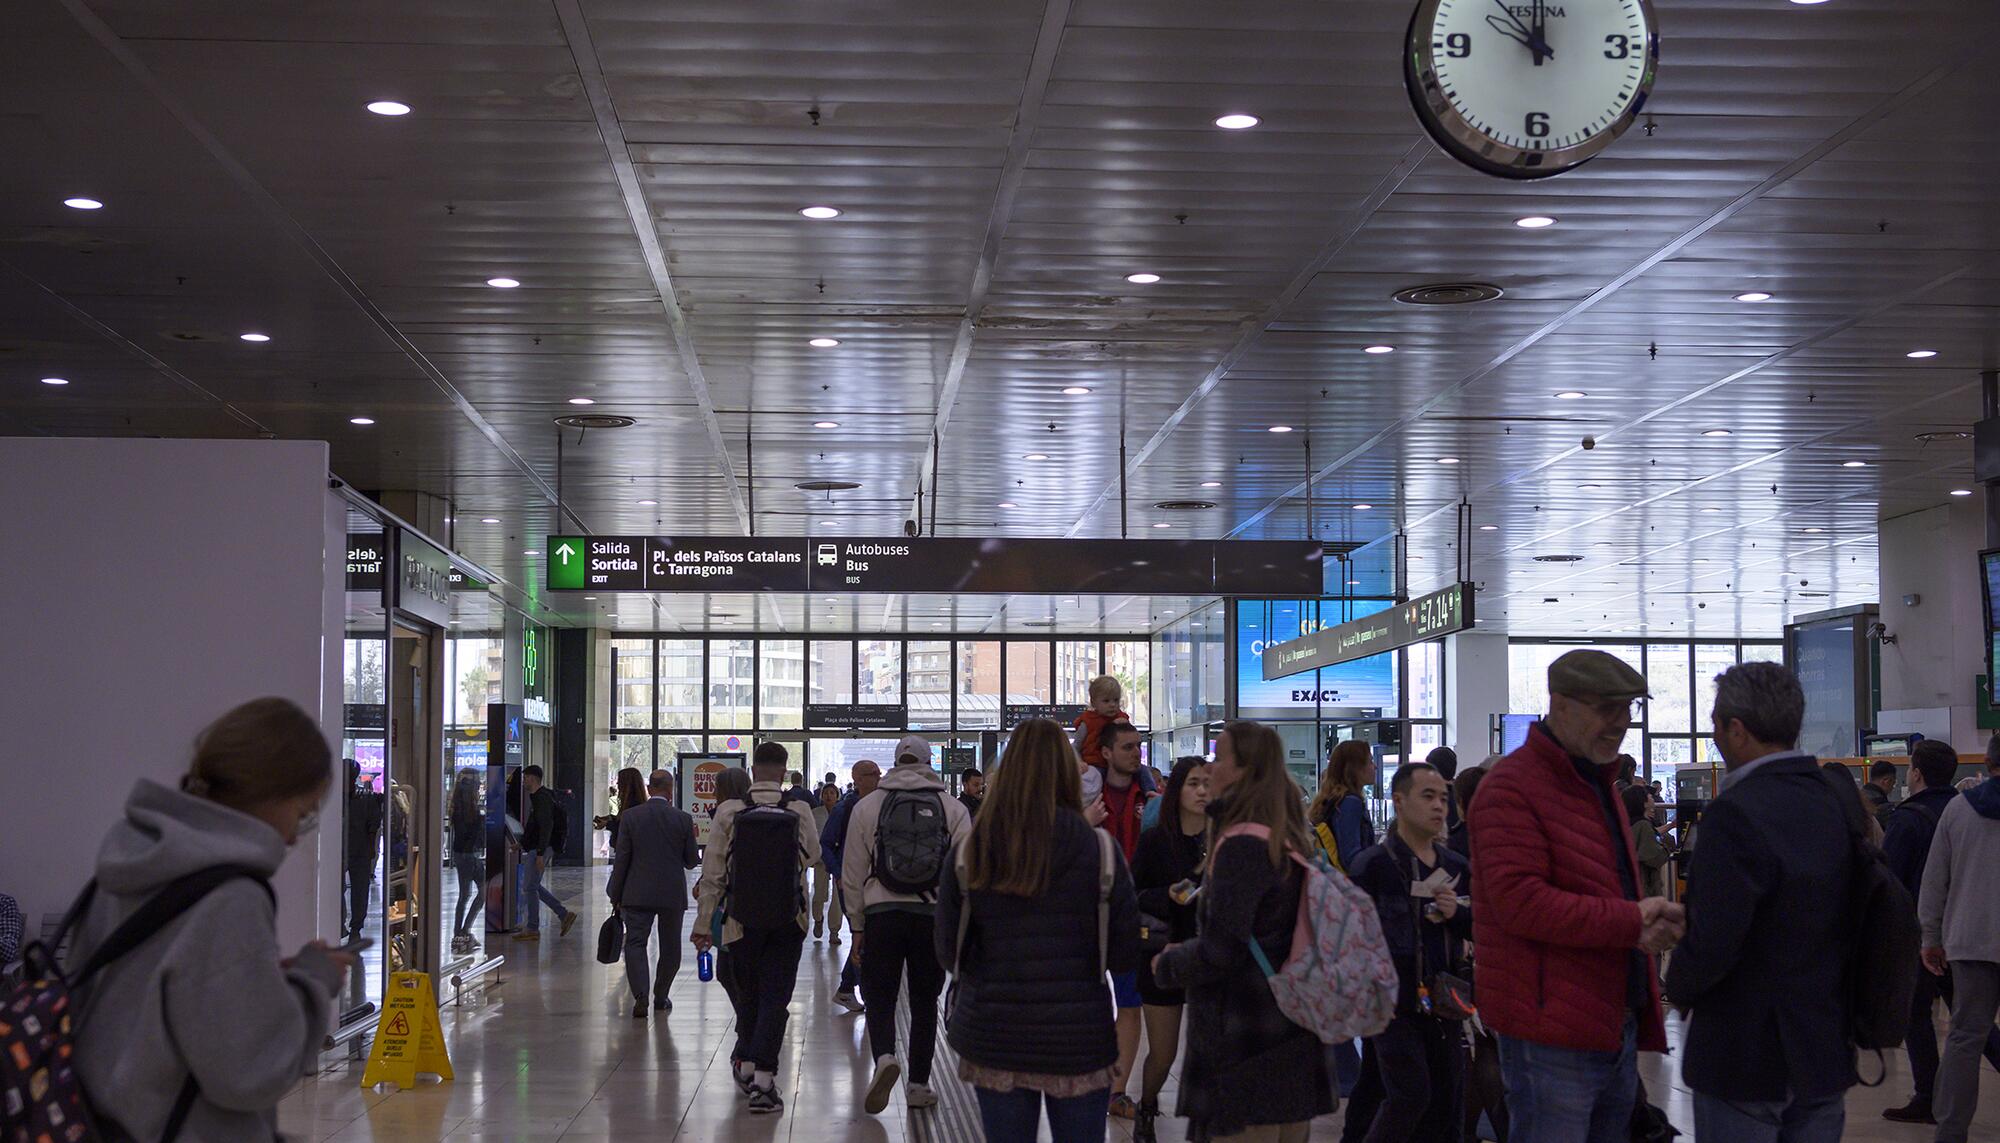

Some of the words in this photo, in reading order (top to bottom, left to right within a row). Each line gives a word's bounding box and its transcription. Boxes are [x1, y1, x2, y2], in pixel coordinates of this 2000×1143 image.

[1509, 5, 1566, 17] FESTNA
[1446, 33, 1471, 58] 9
[1603, 34, 1628, 60] 3
[1525, 112, 1550, 137] 6
[592, 542, 630, 554] Salida
[845, 543, 910, 555] Autobuses
[653, 550, 670, 562] Pl.
[674, 550, 701, 562] dels
[704, 550, 744, 563] Països
[747, 550, 801, 563] Catalans
[591, 558, 638, 571] Sortida
[653, 563, 665, 575] C.
[668, 563, 733, 577] Tarragona
[846, 560, 869, 571] Bus
[592, 575, 609, 583] EXIT
[846, 576, 861, 584] BUS
[1426, 599, 1432, 631] 7
[1436, 594, 1449, 628] 14
[694, 773, 716, 782] BURG
[694, 782, 716, 793] KIN
[692, 802, 700, 813] 3
